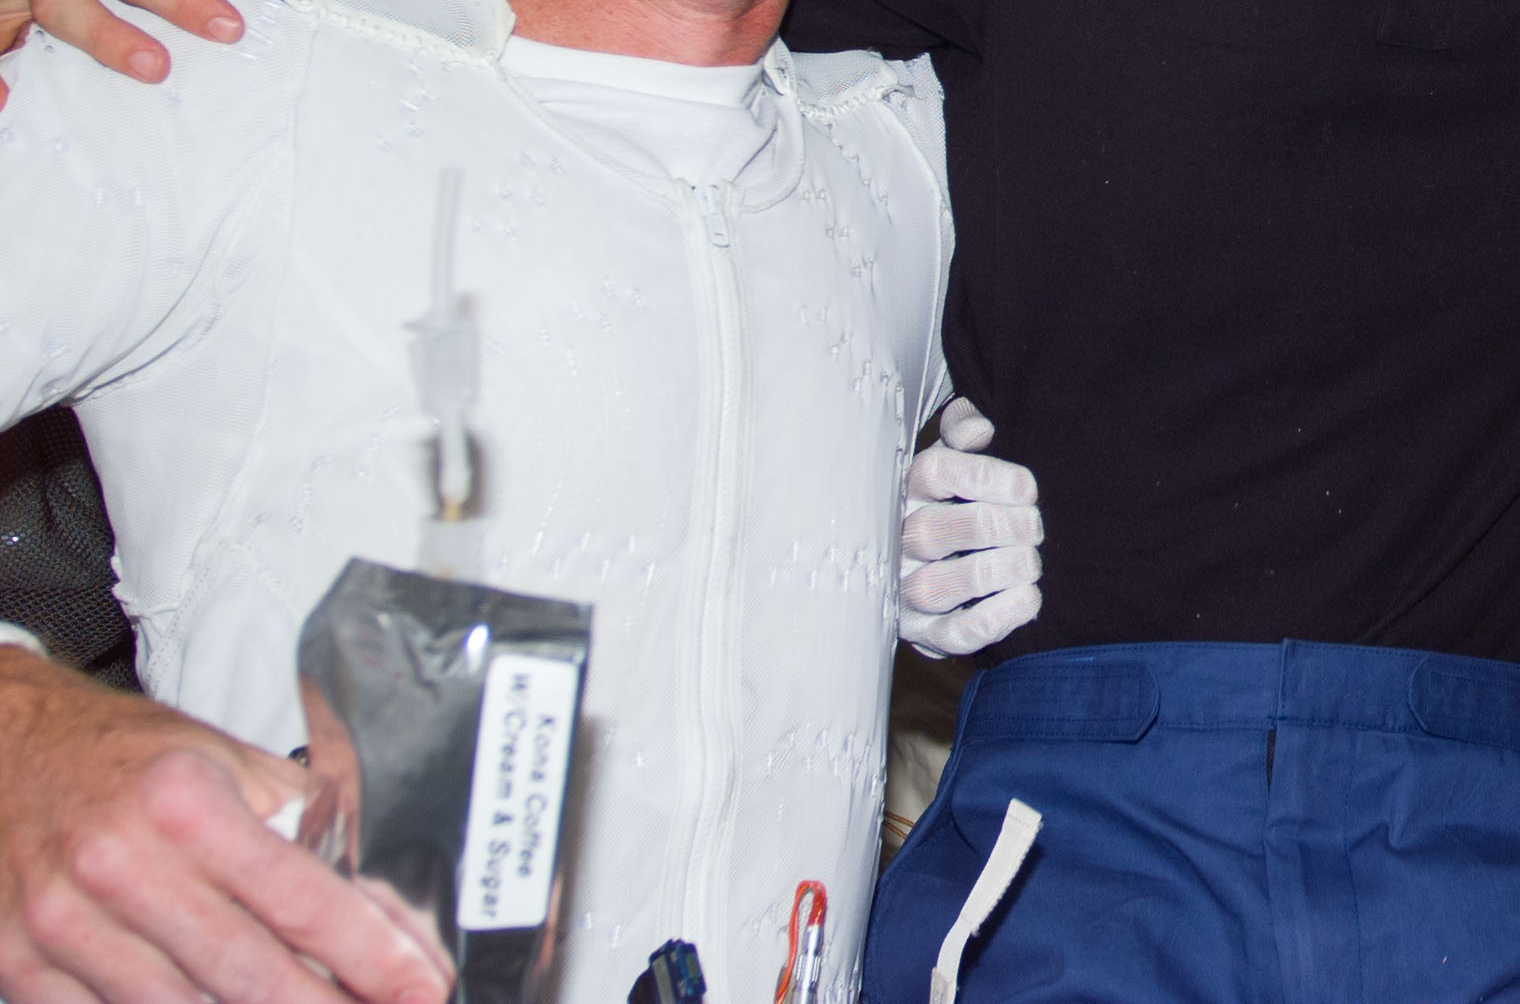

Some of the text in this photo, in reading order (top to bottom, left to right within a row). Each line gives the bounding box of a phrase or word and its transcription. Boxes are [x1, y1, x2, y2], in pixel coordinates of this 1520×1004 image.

[492, 811, 513, 826] &
[518, 715, 556, 879] Kona Coffee
[479, 840, 508, 918] Sugar
